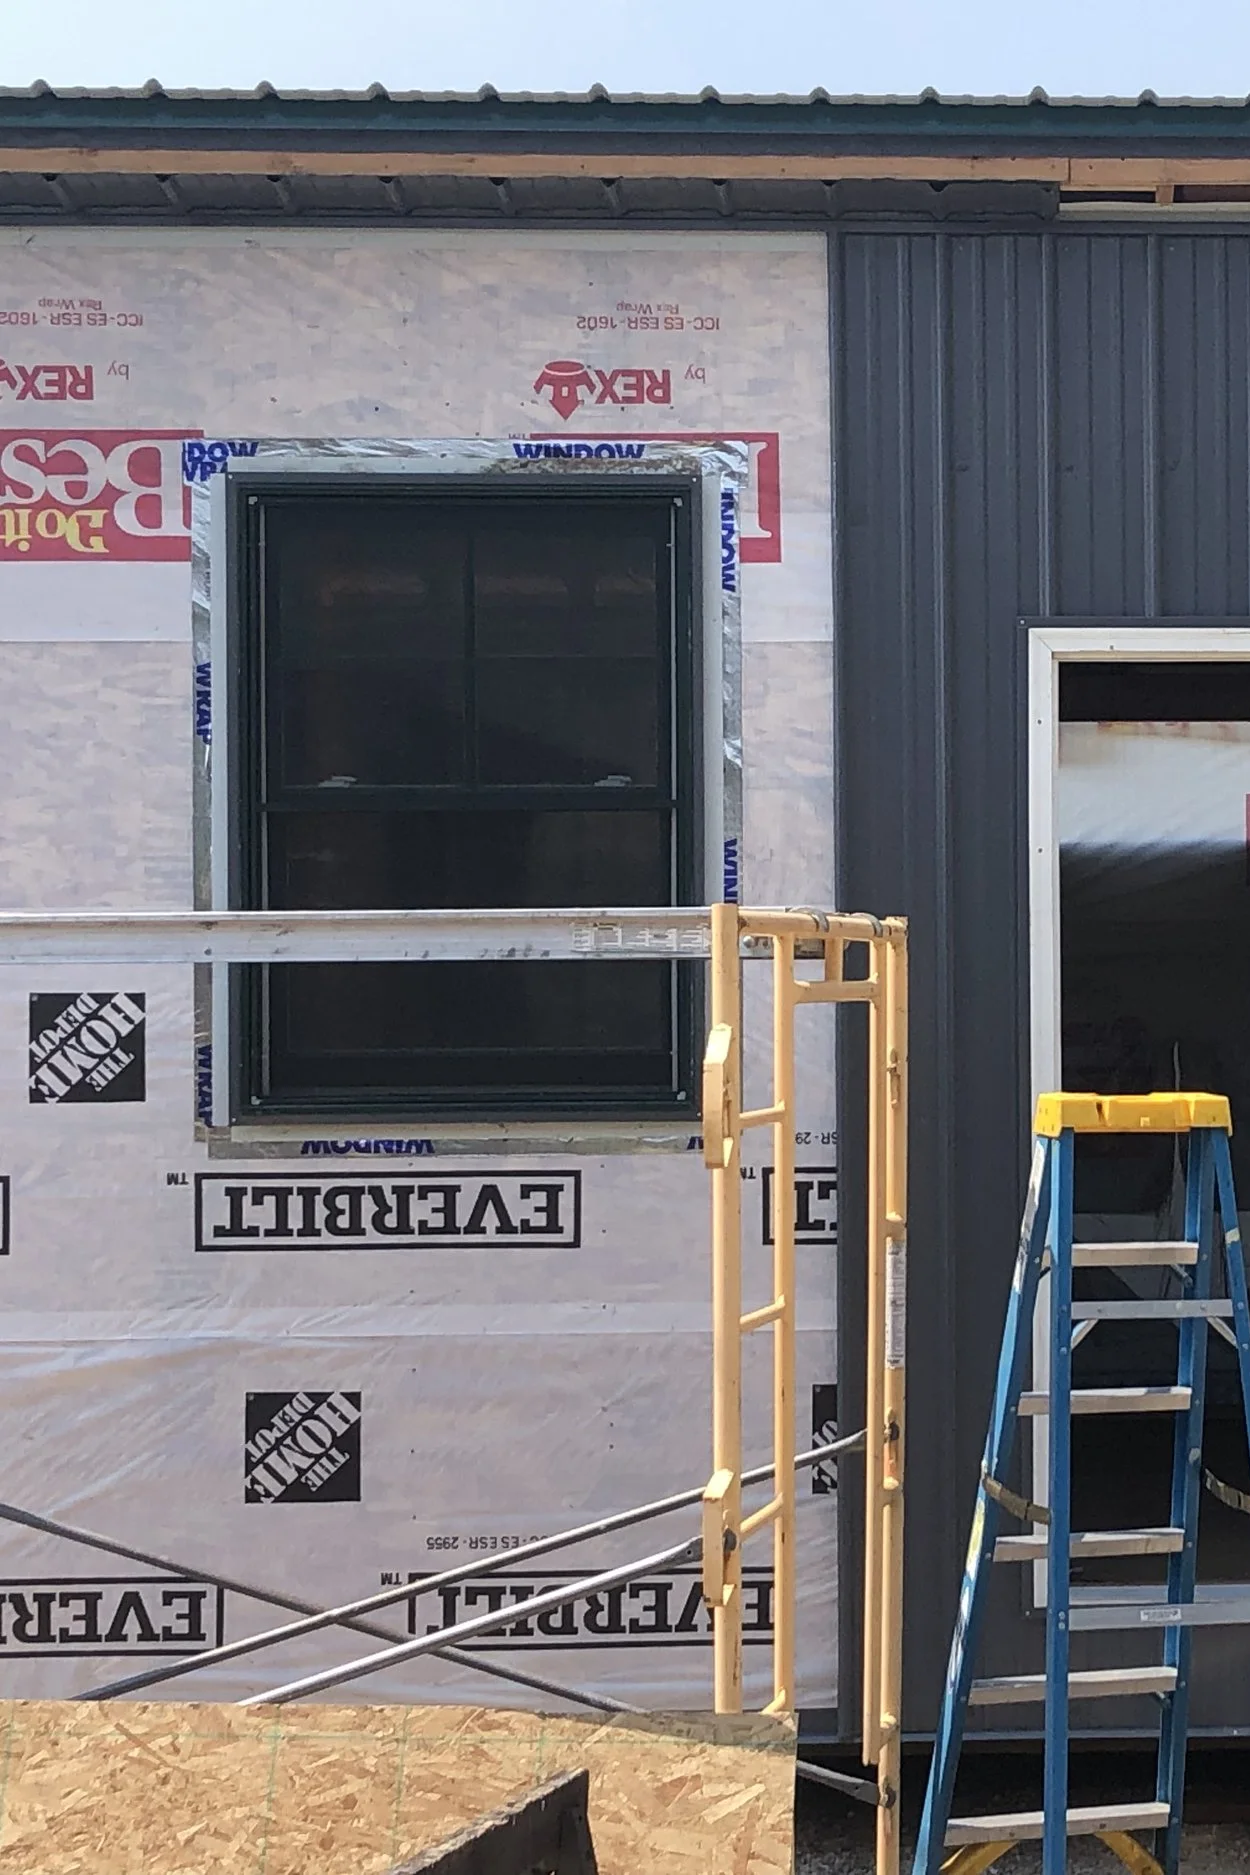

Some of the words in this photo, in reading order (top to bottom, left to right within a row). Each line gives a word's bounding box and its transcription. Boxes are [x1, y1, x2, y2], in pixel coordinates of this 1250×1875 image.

[15, 365, 94, 401] REX
[107, 360, 130, 380] by
[595, 369, 672, 404] REX
[684, 364, 706, 384] by
[0, 438, 192, 538] Bes
[29, 992, 100, 1064] DEPOT
[29, 992, 145, 1103] HOME
[85, 1046, 136, 1092] THE
[213, 1184, 564, 1238] EVERBILT
[245, 1391, 316, 1463] DEPOT
[245, 1391, 361, 1504] HOME
[300, 1446, 351, 1492] THE
[0, 1590, 207, 1645] EVER
